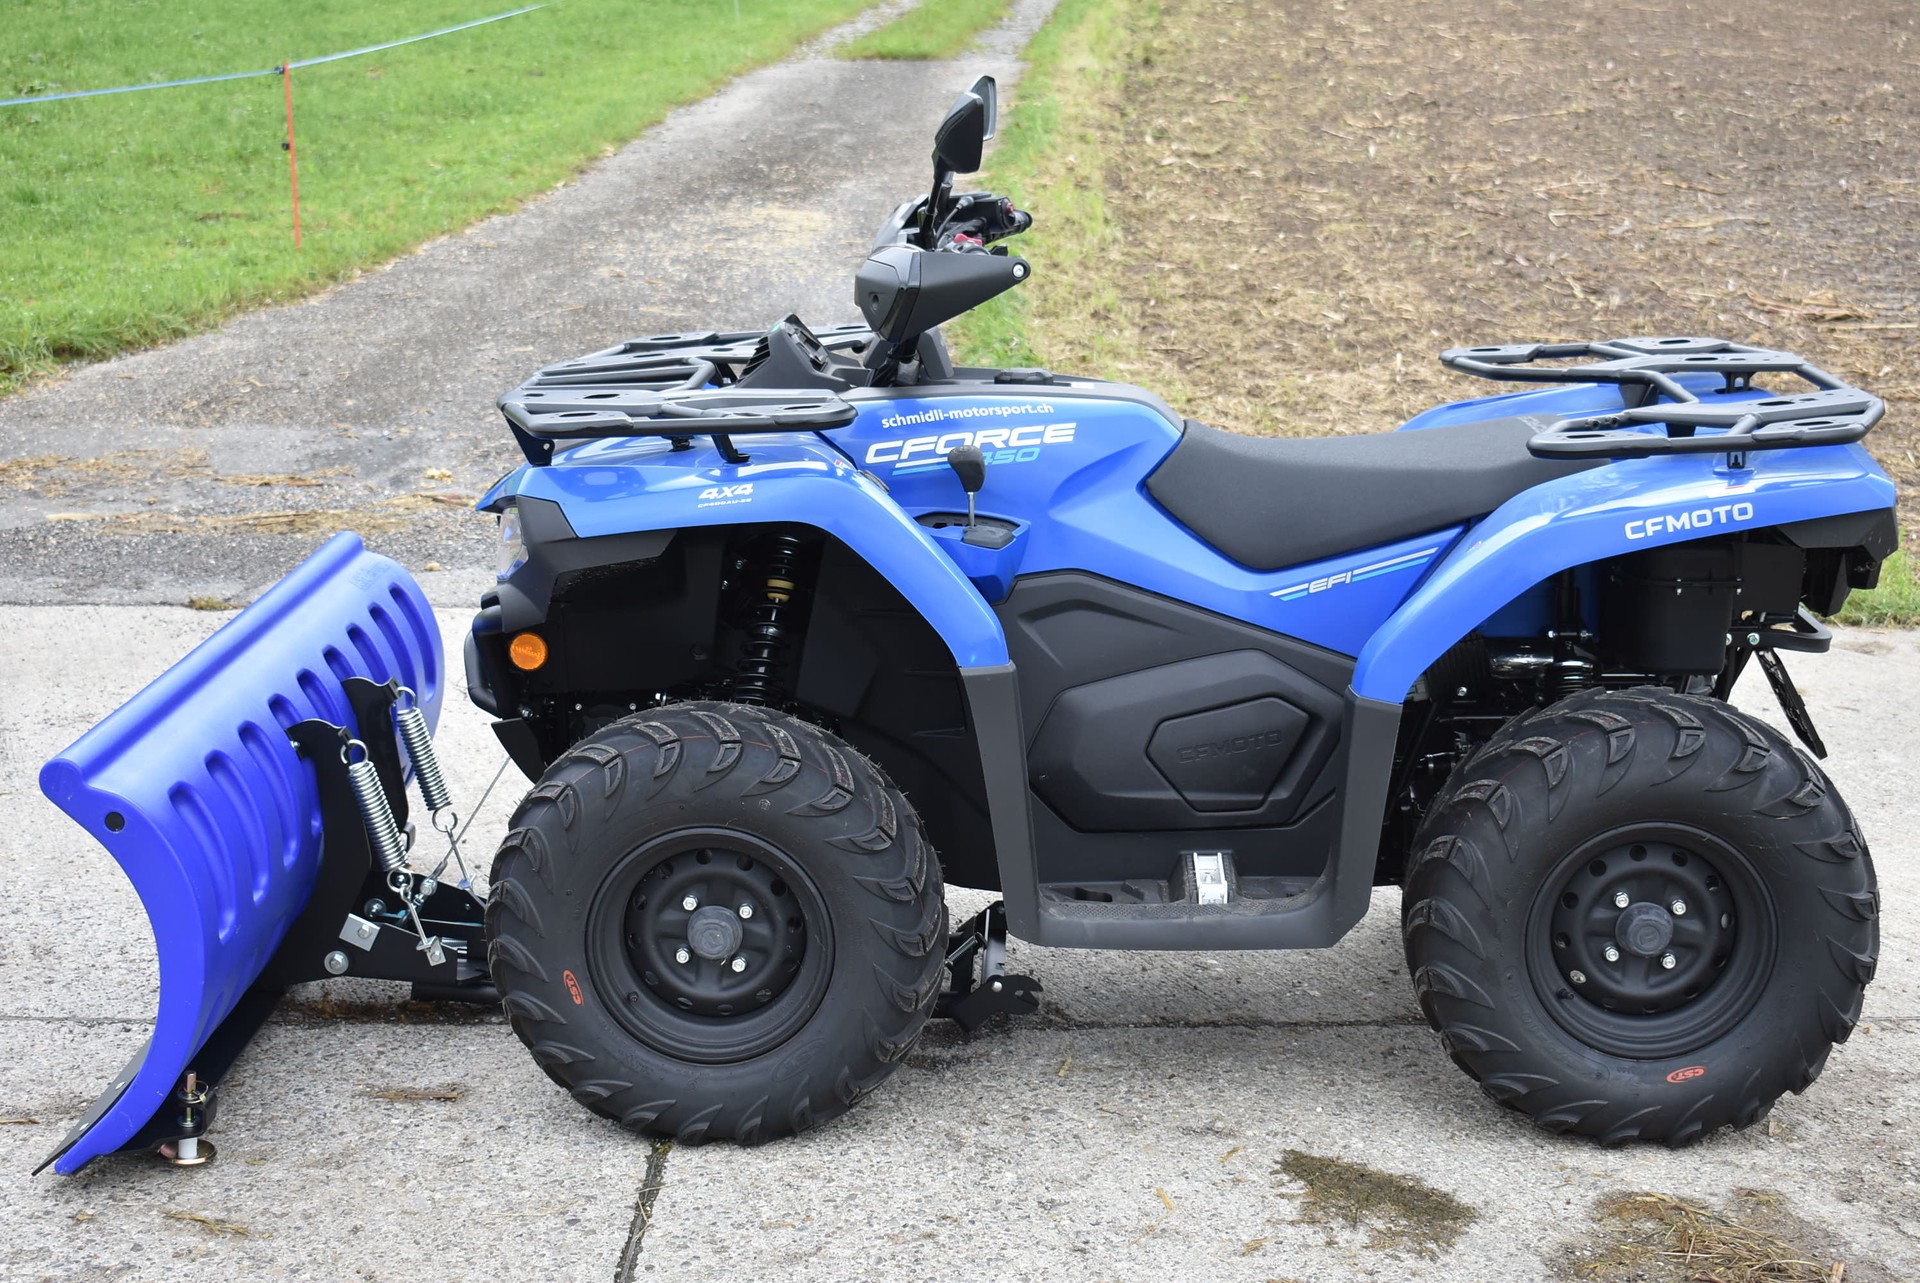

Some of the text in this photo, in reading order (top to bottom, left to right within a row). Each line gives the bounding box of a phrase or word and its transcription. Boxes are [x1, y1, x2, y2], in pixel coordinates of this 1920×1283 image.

[881, 402, 1055, 429] schmidli-motorsport.ch
[865, 422, 1077, 464] CFORCE
[1624, 502, 1754, 540] CFMOTO
[1309, 571, 1352, 594] EFI
[1176, 730, 1283, 764] CFMOTO
[565, 977, 583, 1005] CST
[1674, 1067, 1705, 1081] CST
